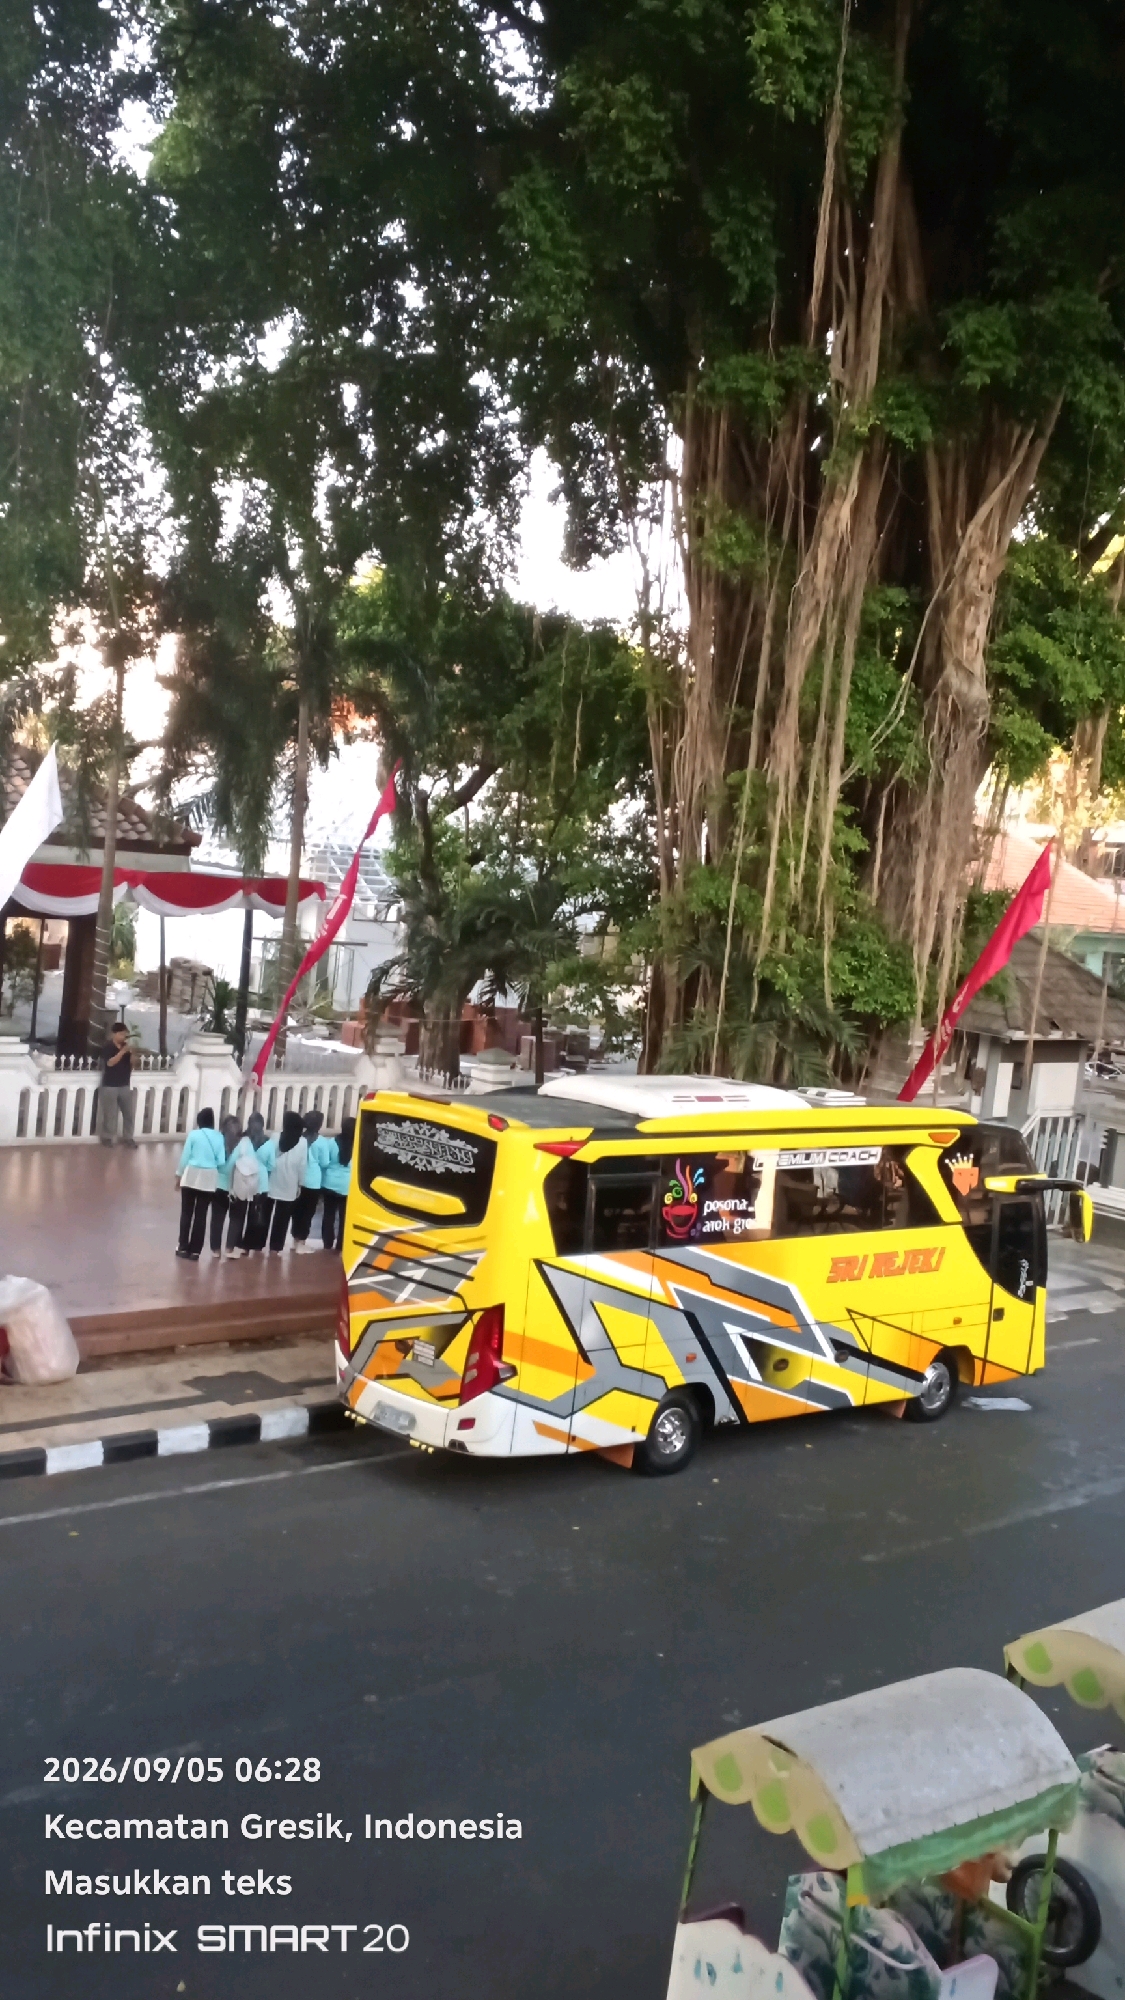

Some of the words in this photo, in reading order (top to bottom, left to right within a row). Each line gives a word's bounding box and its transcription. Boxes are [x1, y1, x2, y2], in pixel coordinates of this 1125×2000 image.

[827, 1150, 880, 1164] COACH
[826, 1254, 869, 1284] SRI
[868, 1246, 947, 1279] REJEKI
